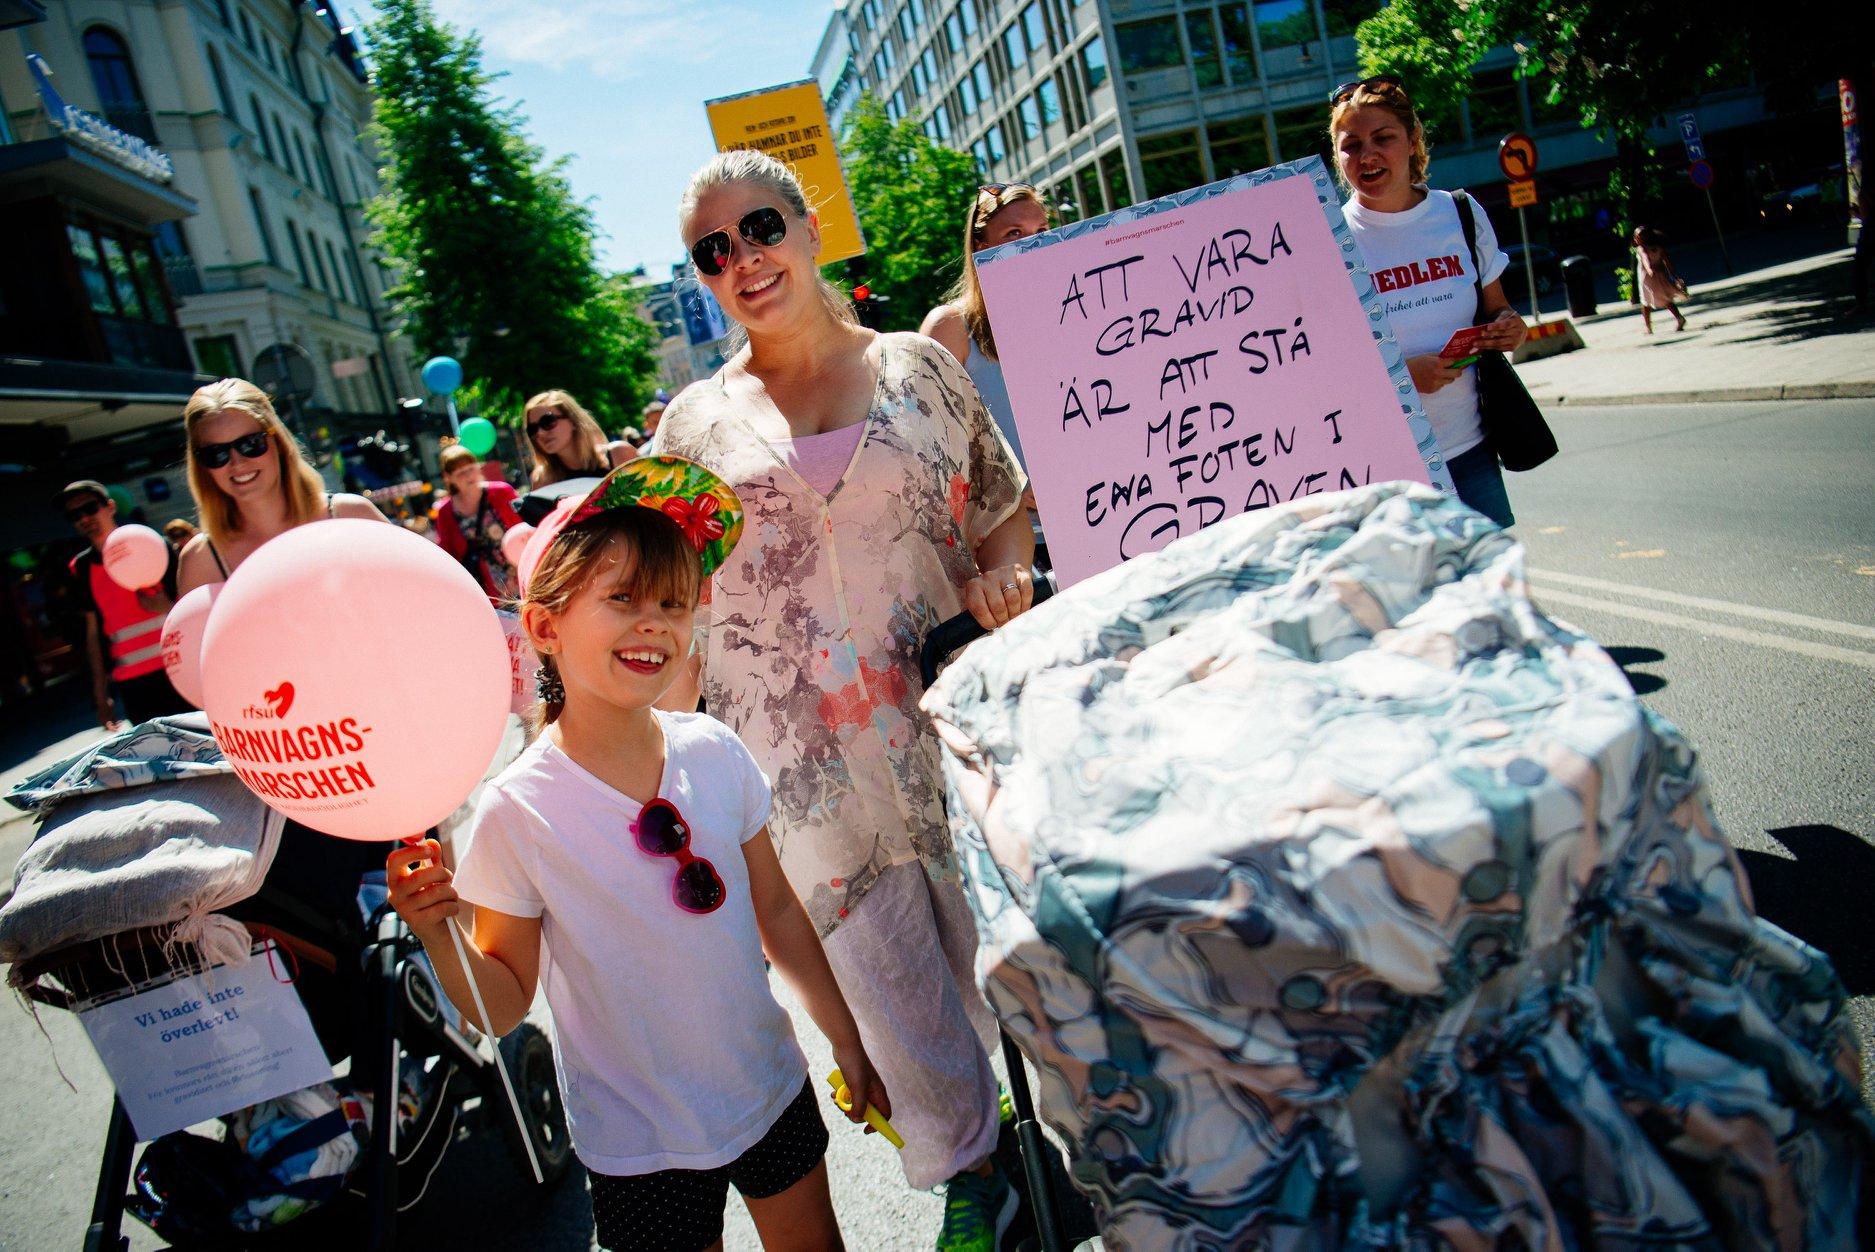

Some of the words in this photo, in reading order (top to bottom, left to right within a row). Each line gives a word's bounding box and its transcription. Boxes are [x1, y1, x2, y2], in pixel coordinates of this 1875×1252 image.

[787, 143, 819, 161] BILDER
[789, 129, 801, 143] DU
[803, 125, 823, 140] INTE
[1105, 219, 1185, 246] #barnvagnsmarschen
[1060, 255, 1144, 325] ATT
[1172, 221, 1293, 293] VARA
[1370, 254, 1465, 294] EDLEM
[1096, 285, 1255, 356] GRAVID
[1415, 296, 1429, 308] att
[1431, 292, 1454, 303] vara
[1060, 376, 1131, 433] ÄR
[1160, 350, 1219, 401] ATT
[1239, 316, 1311, 375] STÅ
[1146, 402, 1235, 458] MED
[1169, 425, 1296, 493] FOTEN
[1323, 409, 1343, 445] I
[242, 703, 275, 720] rfsu
[212, 717, 374, 764] BARNVAGNS-
[134, 1012, 157, 1028] Vi
[158, 999, 201, 1021] hade
[206, 985, 245, 1005] inte
[160, 1006, 240, 1043] överlevt!
